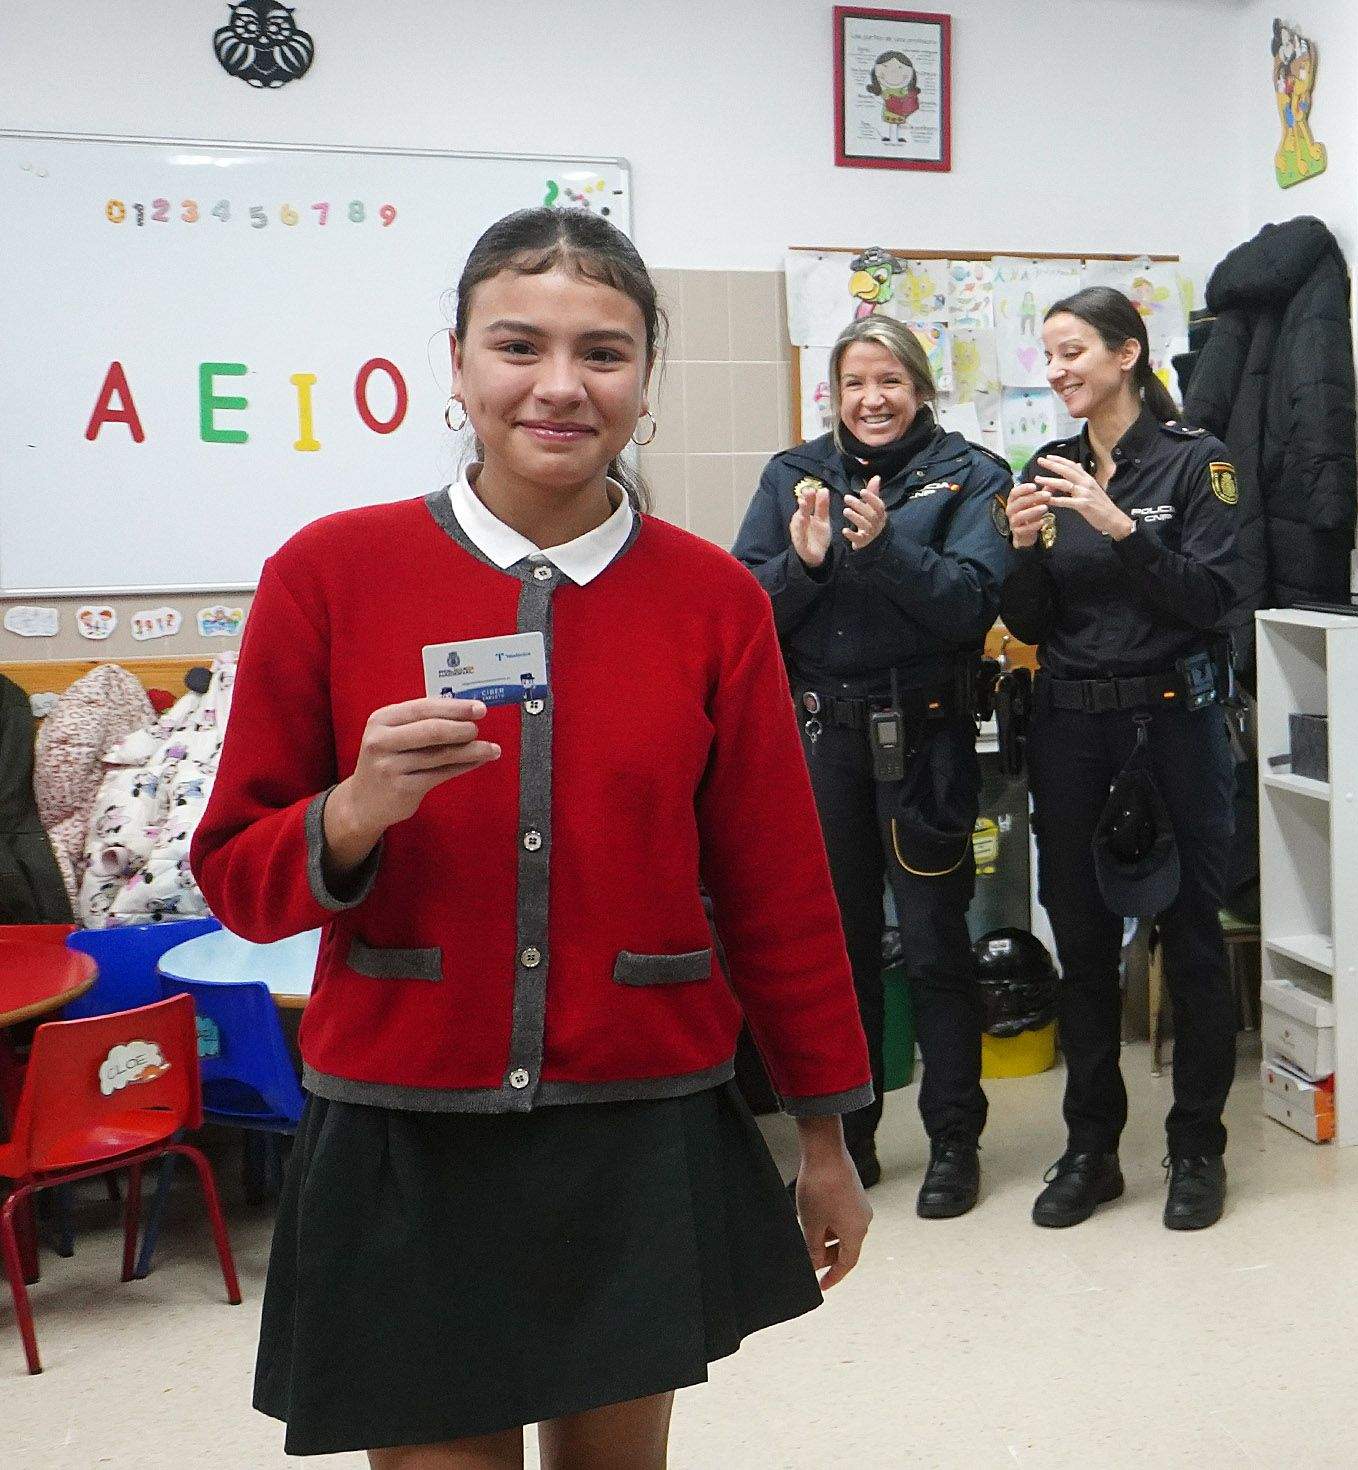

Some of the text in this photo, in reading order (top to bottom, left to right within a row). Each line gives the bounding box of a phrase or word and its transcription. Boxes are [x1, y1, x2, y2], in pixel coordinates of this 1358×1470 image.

[84, 357, 409, 452] A E I O
[106, 1053, 149, 1080] CLOE
